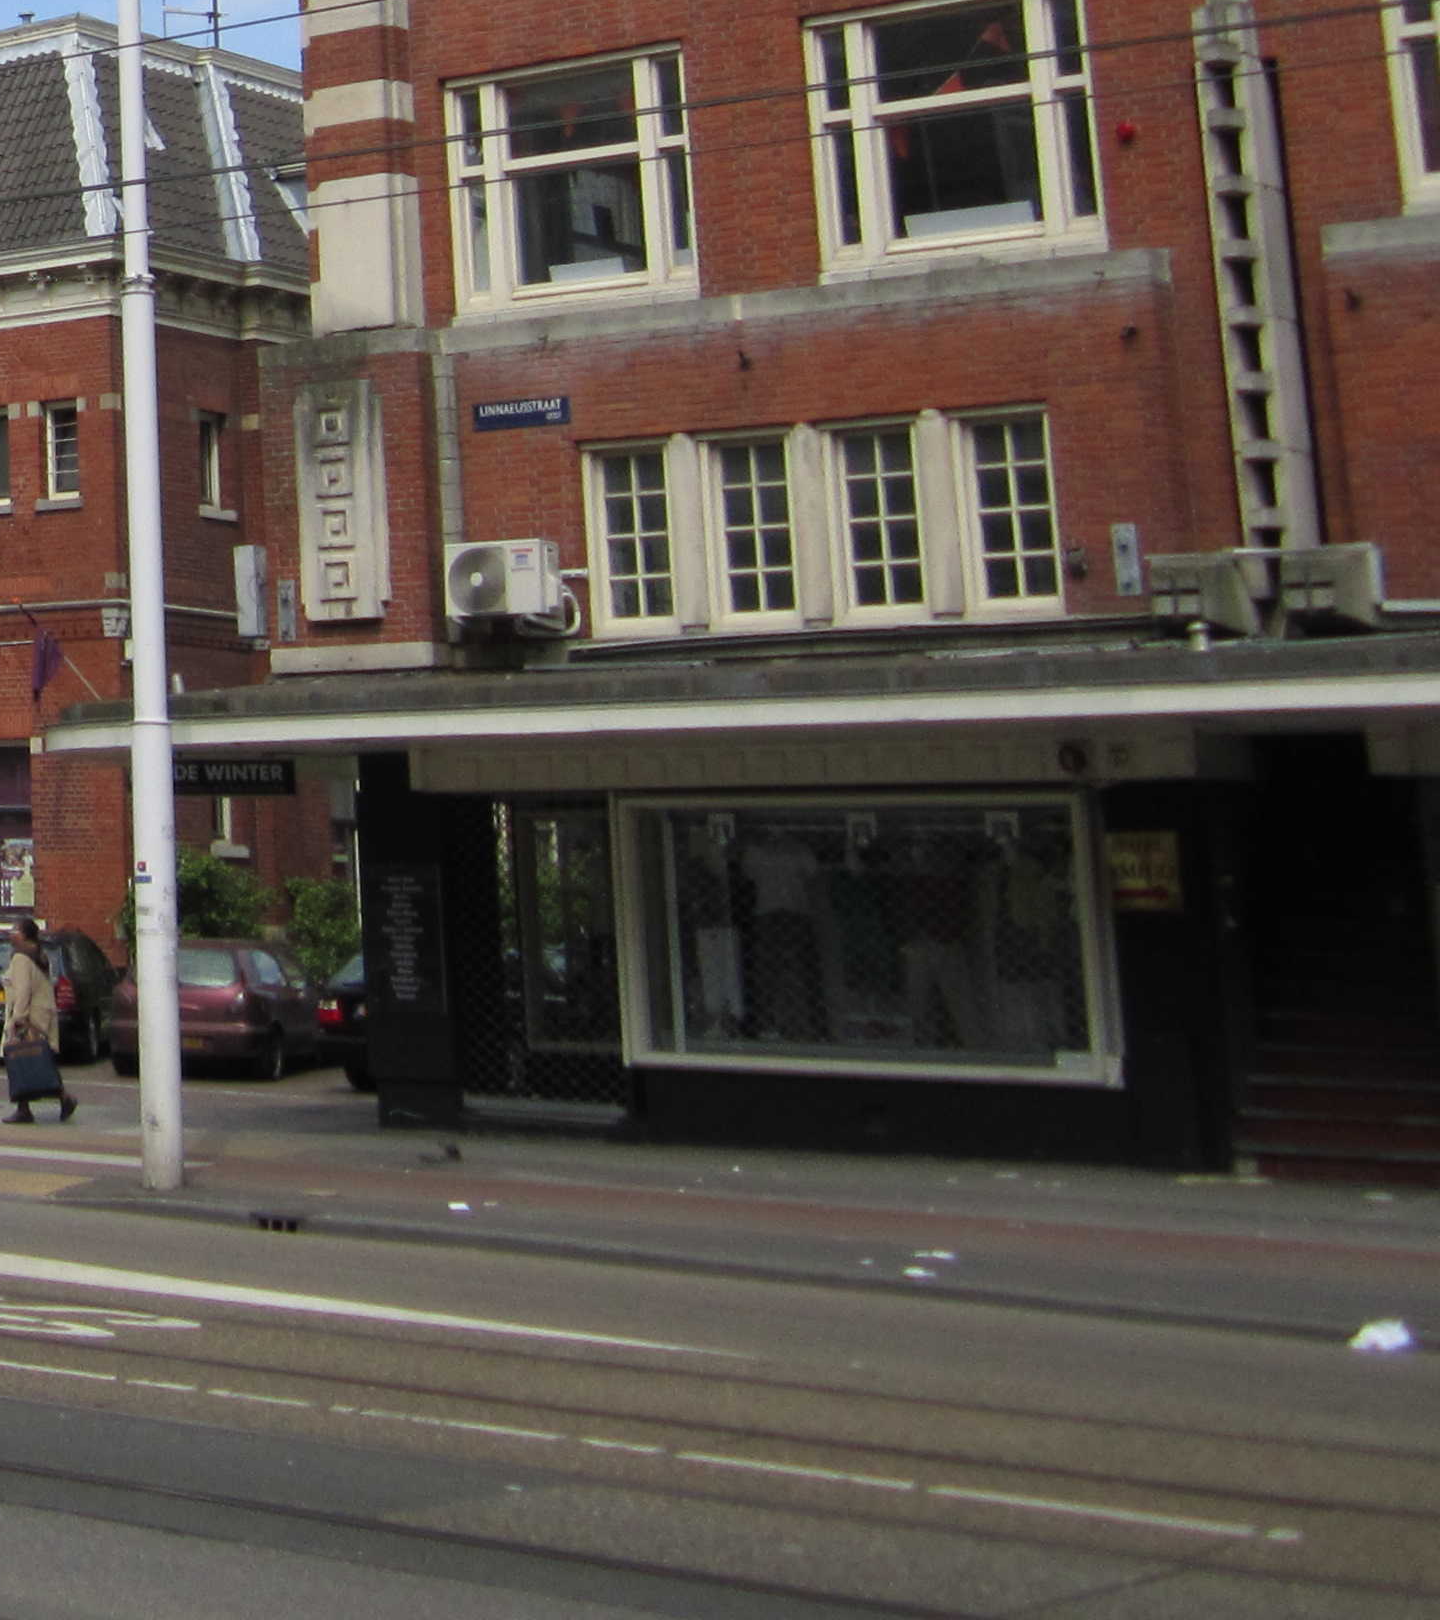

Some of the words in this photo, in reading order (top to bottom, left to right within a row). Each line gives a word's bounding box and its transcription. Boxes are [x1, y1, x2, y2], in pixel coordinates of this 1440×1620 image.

[480, 398, 560, 417] LINNAEUSSTRAAT
[175, 764, 199, 780] DE
[204, 763, 283, 781] WINTER
